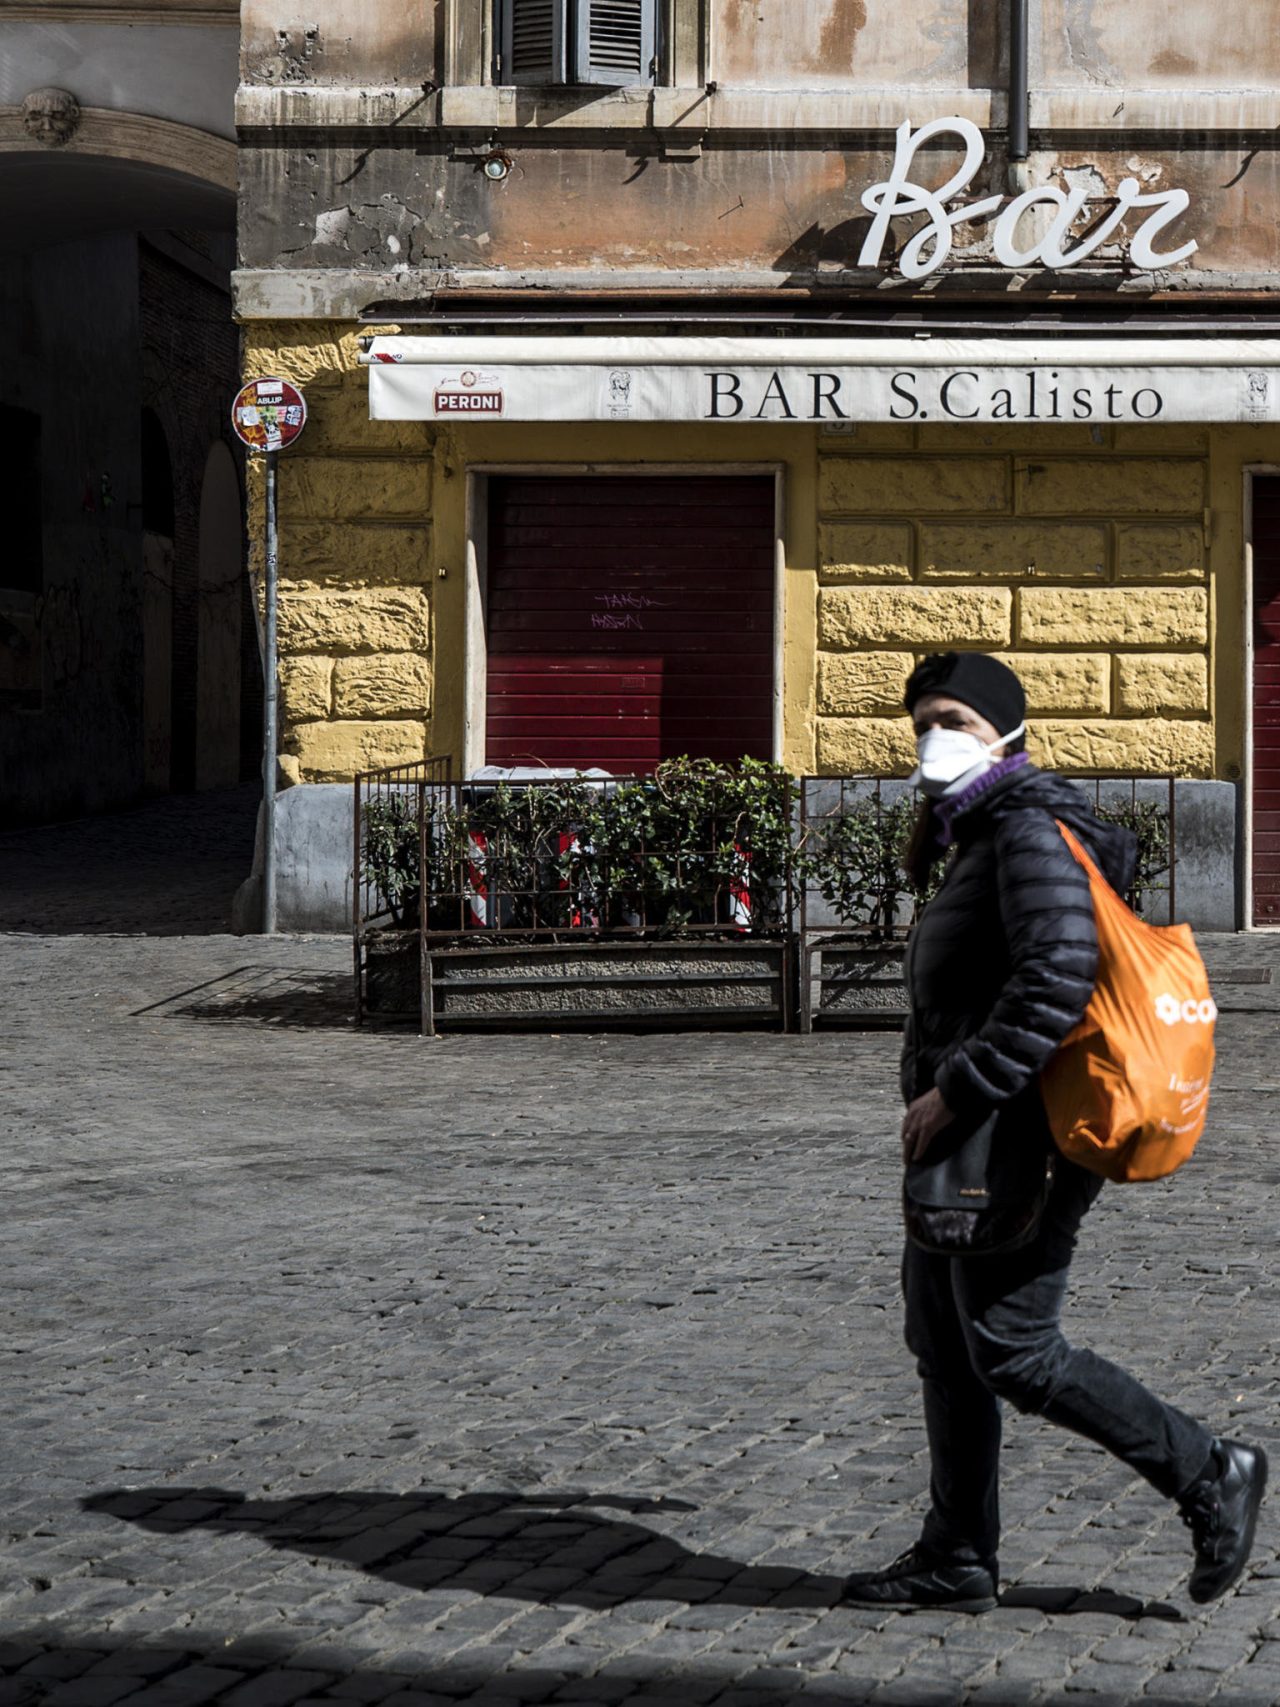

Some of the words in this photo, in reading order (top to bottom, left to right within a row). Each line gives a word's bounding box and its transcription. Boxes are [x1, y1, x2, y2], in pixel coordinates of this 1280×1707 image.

[857, 116, 1199, 281] Bar
[438, 395, 499, 409] PERONI
[704, 371, 850, 419] BAR
